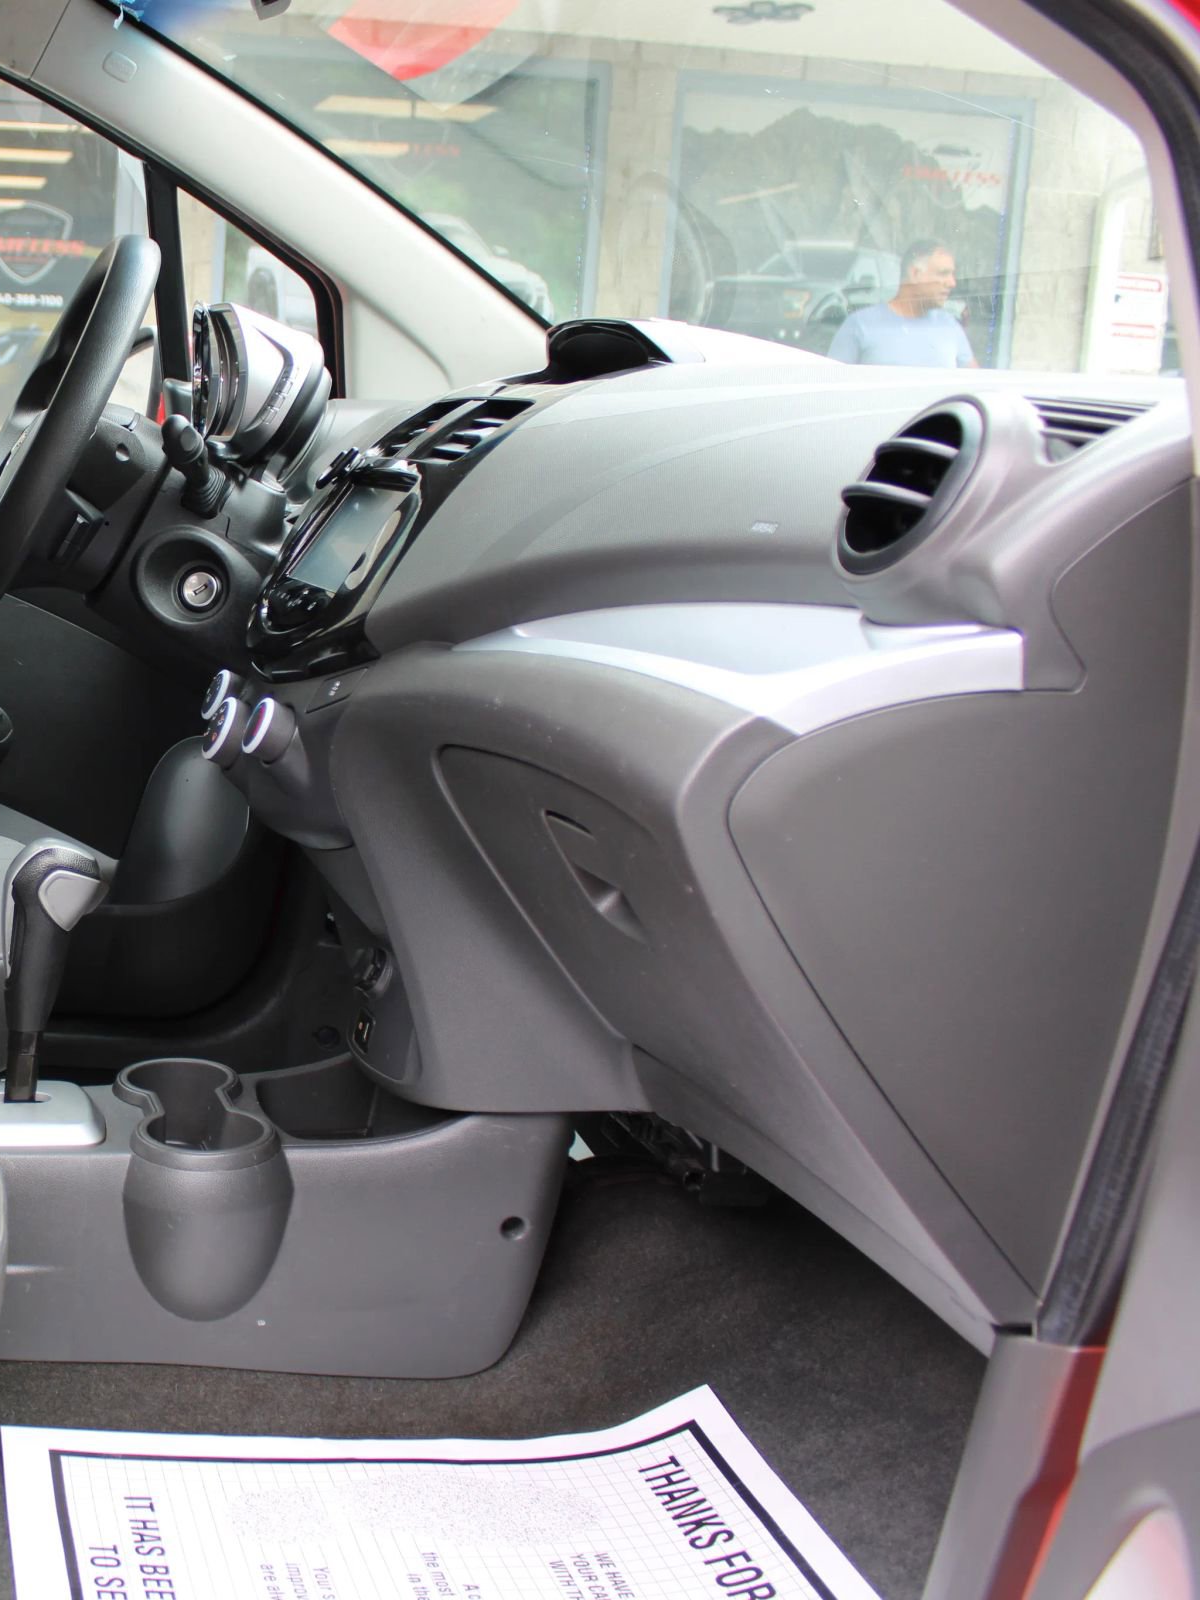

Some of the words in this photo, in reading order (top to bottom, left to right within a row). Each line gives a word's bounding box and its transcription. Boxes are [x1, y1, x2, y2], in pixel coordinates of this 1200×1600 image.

[123, 1496, 156, 1512] IT
[128, 1519, 166, 1557] HAS
[638, 1455, 735, 1550] THANKS
[703, 1550, 777, 1600] FOR
[88, 1544, 122, 1568] TO
[594, 1552, 616, 1571] WE
[260, 1564, 277, 1582] are
[313, 1566, 332, 1591] Your
[407, 1573, 422, 1584] in
[421, 1551, 441, 1569] the
[431, 1571, 456, 1598] most
[549, 1560, 577, 1589] WITH
[570, 1552, 599, 1583] YOUR
[587, 1583, 615, 1600] CA
[604, 1570, 636, 1599] HAVE
[463, 1583, 480, 1592] A
